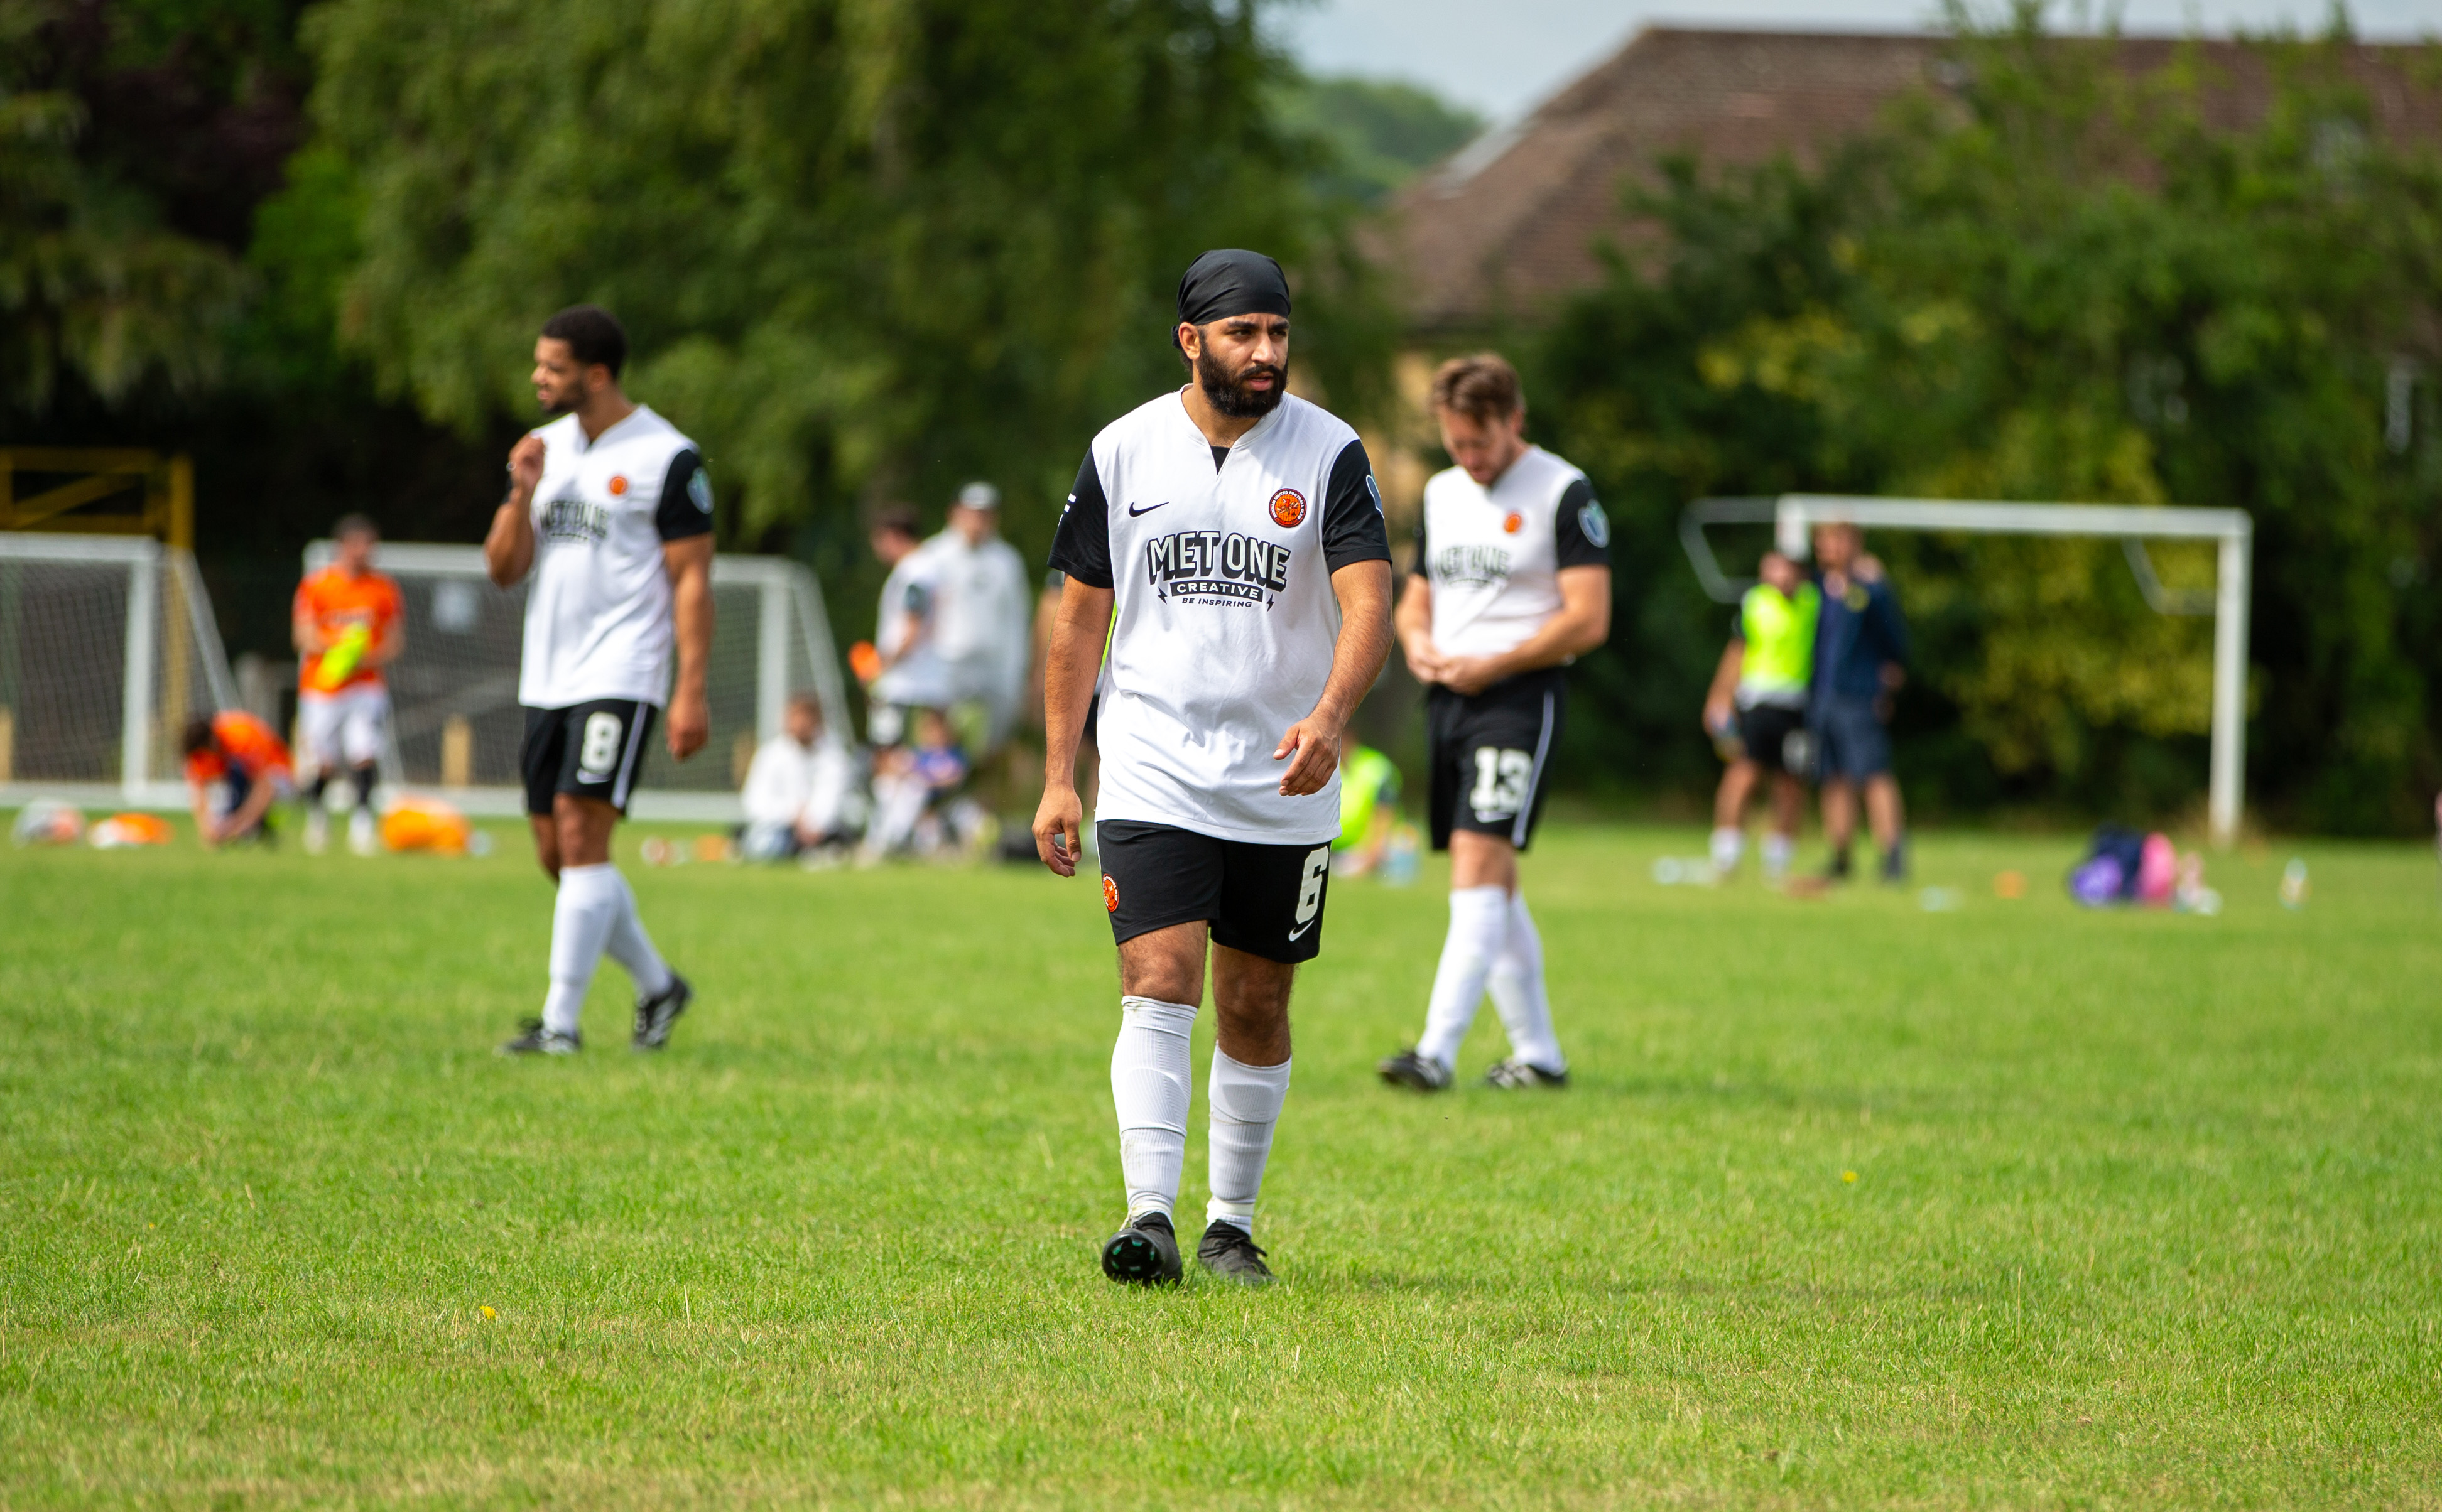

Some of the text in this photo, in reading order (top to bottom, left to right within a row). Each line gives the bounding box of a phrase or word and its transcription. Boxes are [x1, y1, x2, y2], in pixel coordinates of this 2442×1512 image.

[1147, 531, 1291, 593] MET ONE
[1176, 582, 1260, 598] CREATIVE
[1198, 598, 1252, 608] INSPIRING
[580, 711, 623, 775] 8
[1469, 746, 1533, 813] 13
[1295, 845, 1329, 925] 6
